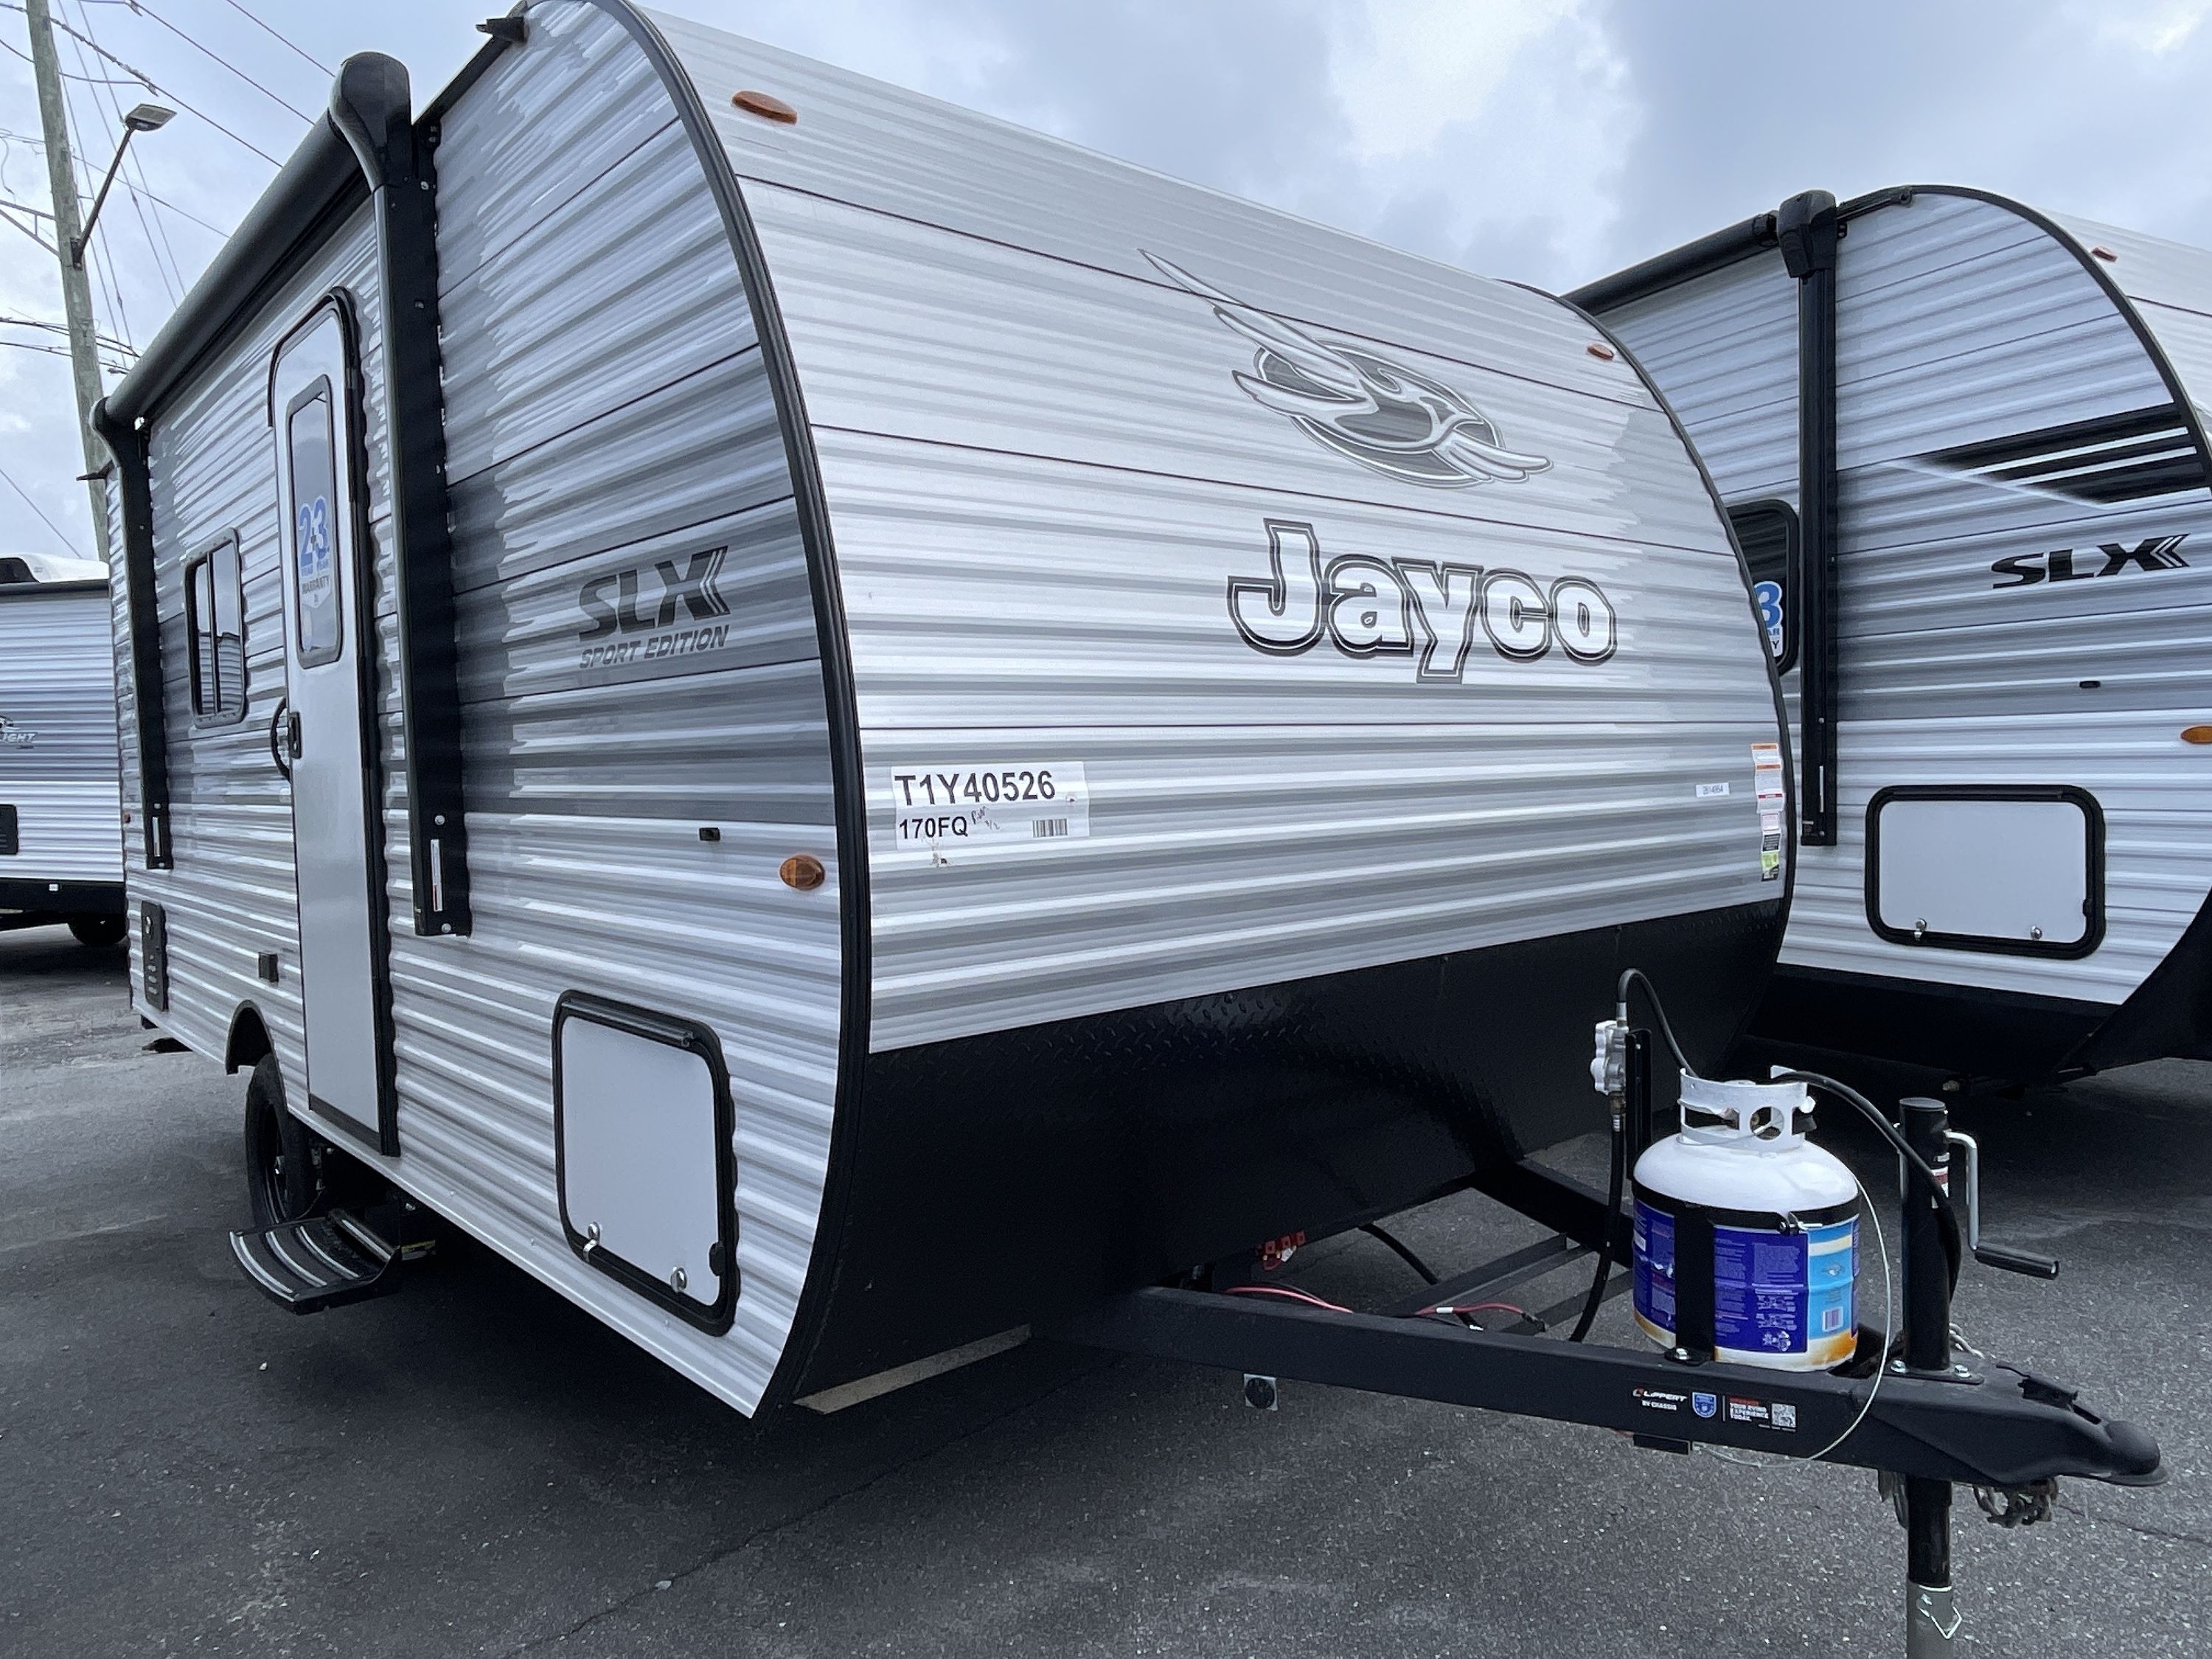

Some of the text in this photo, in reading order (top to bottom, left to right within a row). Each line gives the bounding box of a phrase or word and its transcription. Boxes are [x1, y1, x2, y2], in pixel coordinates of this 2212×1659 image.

[1991, 533, 2191, 589] SLX
[579, 545, 731, 641] SLX
[1227, 518, 1618, 684] Jayco
[580, 625, 729, 668] SPORT EDITION
[894, 771, 1055, 806] T1Y40526
[900, 815, 968, 839] 170FQ
